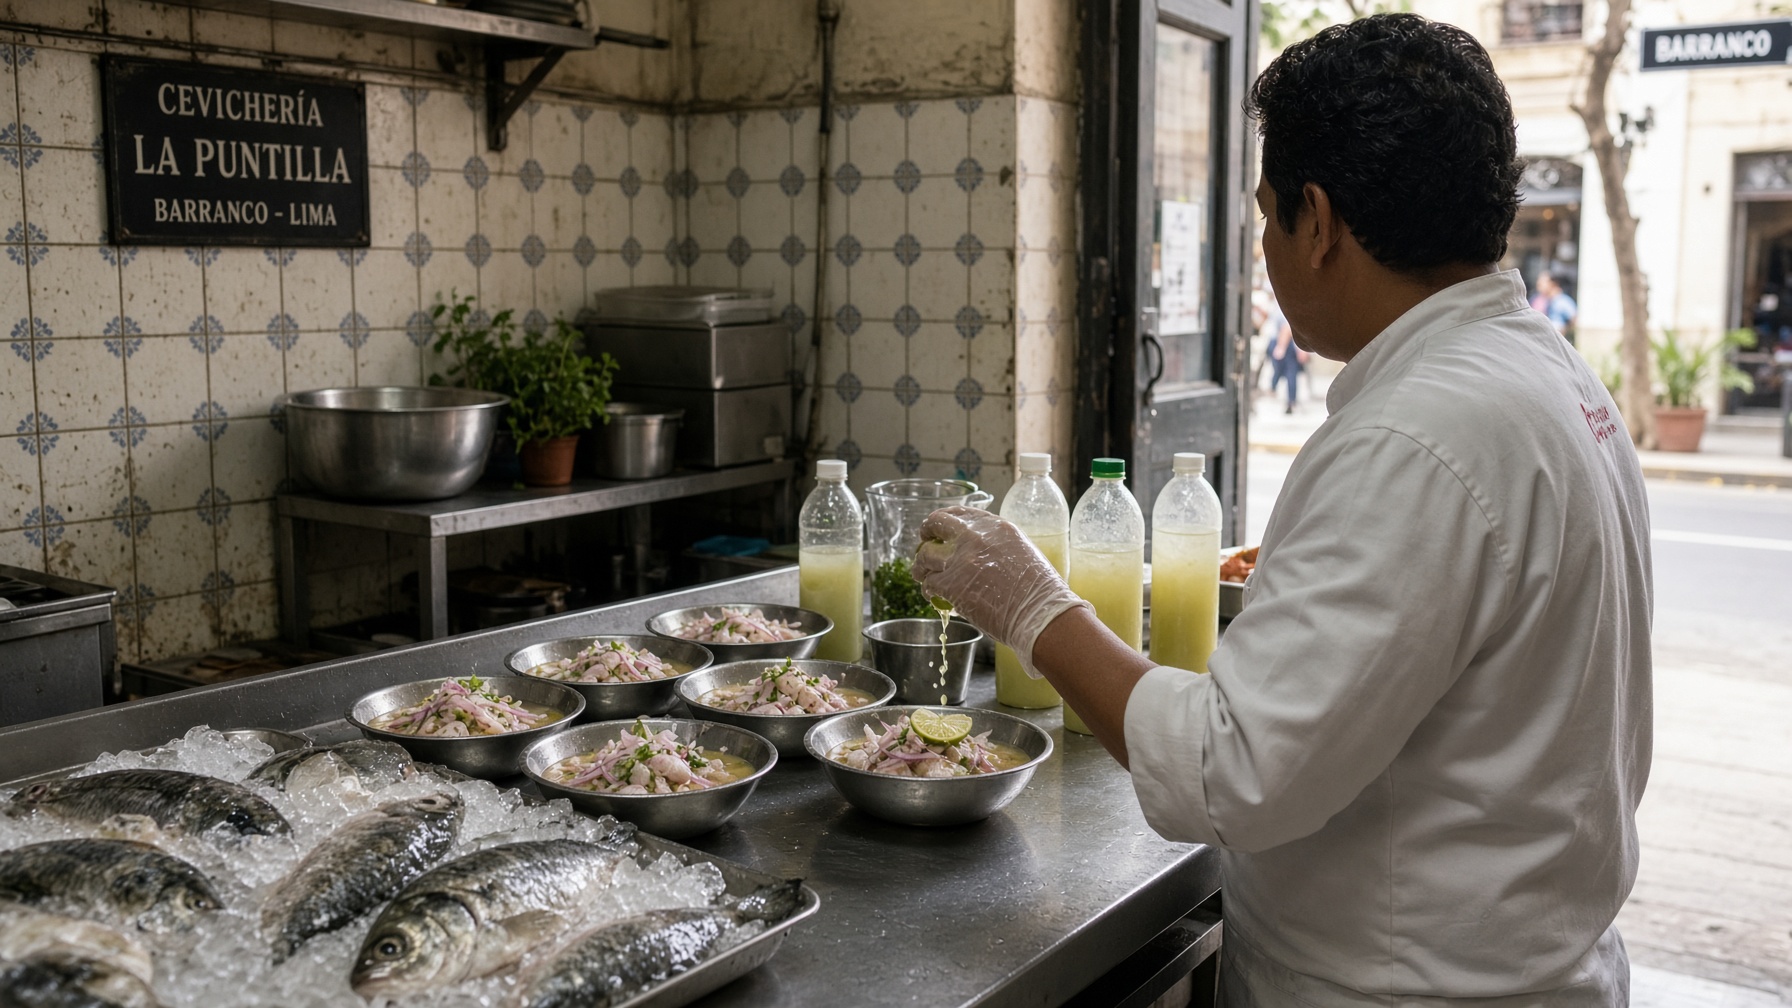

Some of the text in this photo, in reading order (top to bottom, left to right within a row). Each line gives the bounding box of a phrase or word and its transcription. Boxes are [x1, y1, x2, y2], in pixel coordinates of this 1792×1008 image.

[1655, 29, 1772, 63] BARRANCO
[158, 82, 324, 127] CEVICHERÍA
[133, 134, 351, 183] LA PUNTILLA
[154, 198, 268, 225] BARRANCO
[289, 202, 337, 226] LIMA
